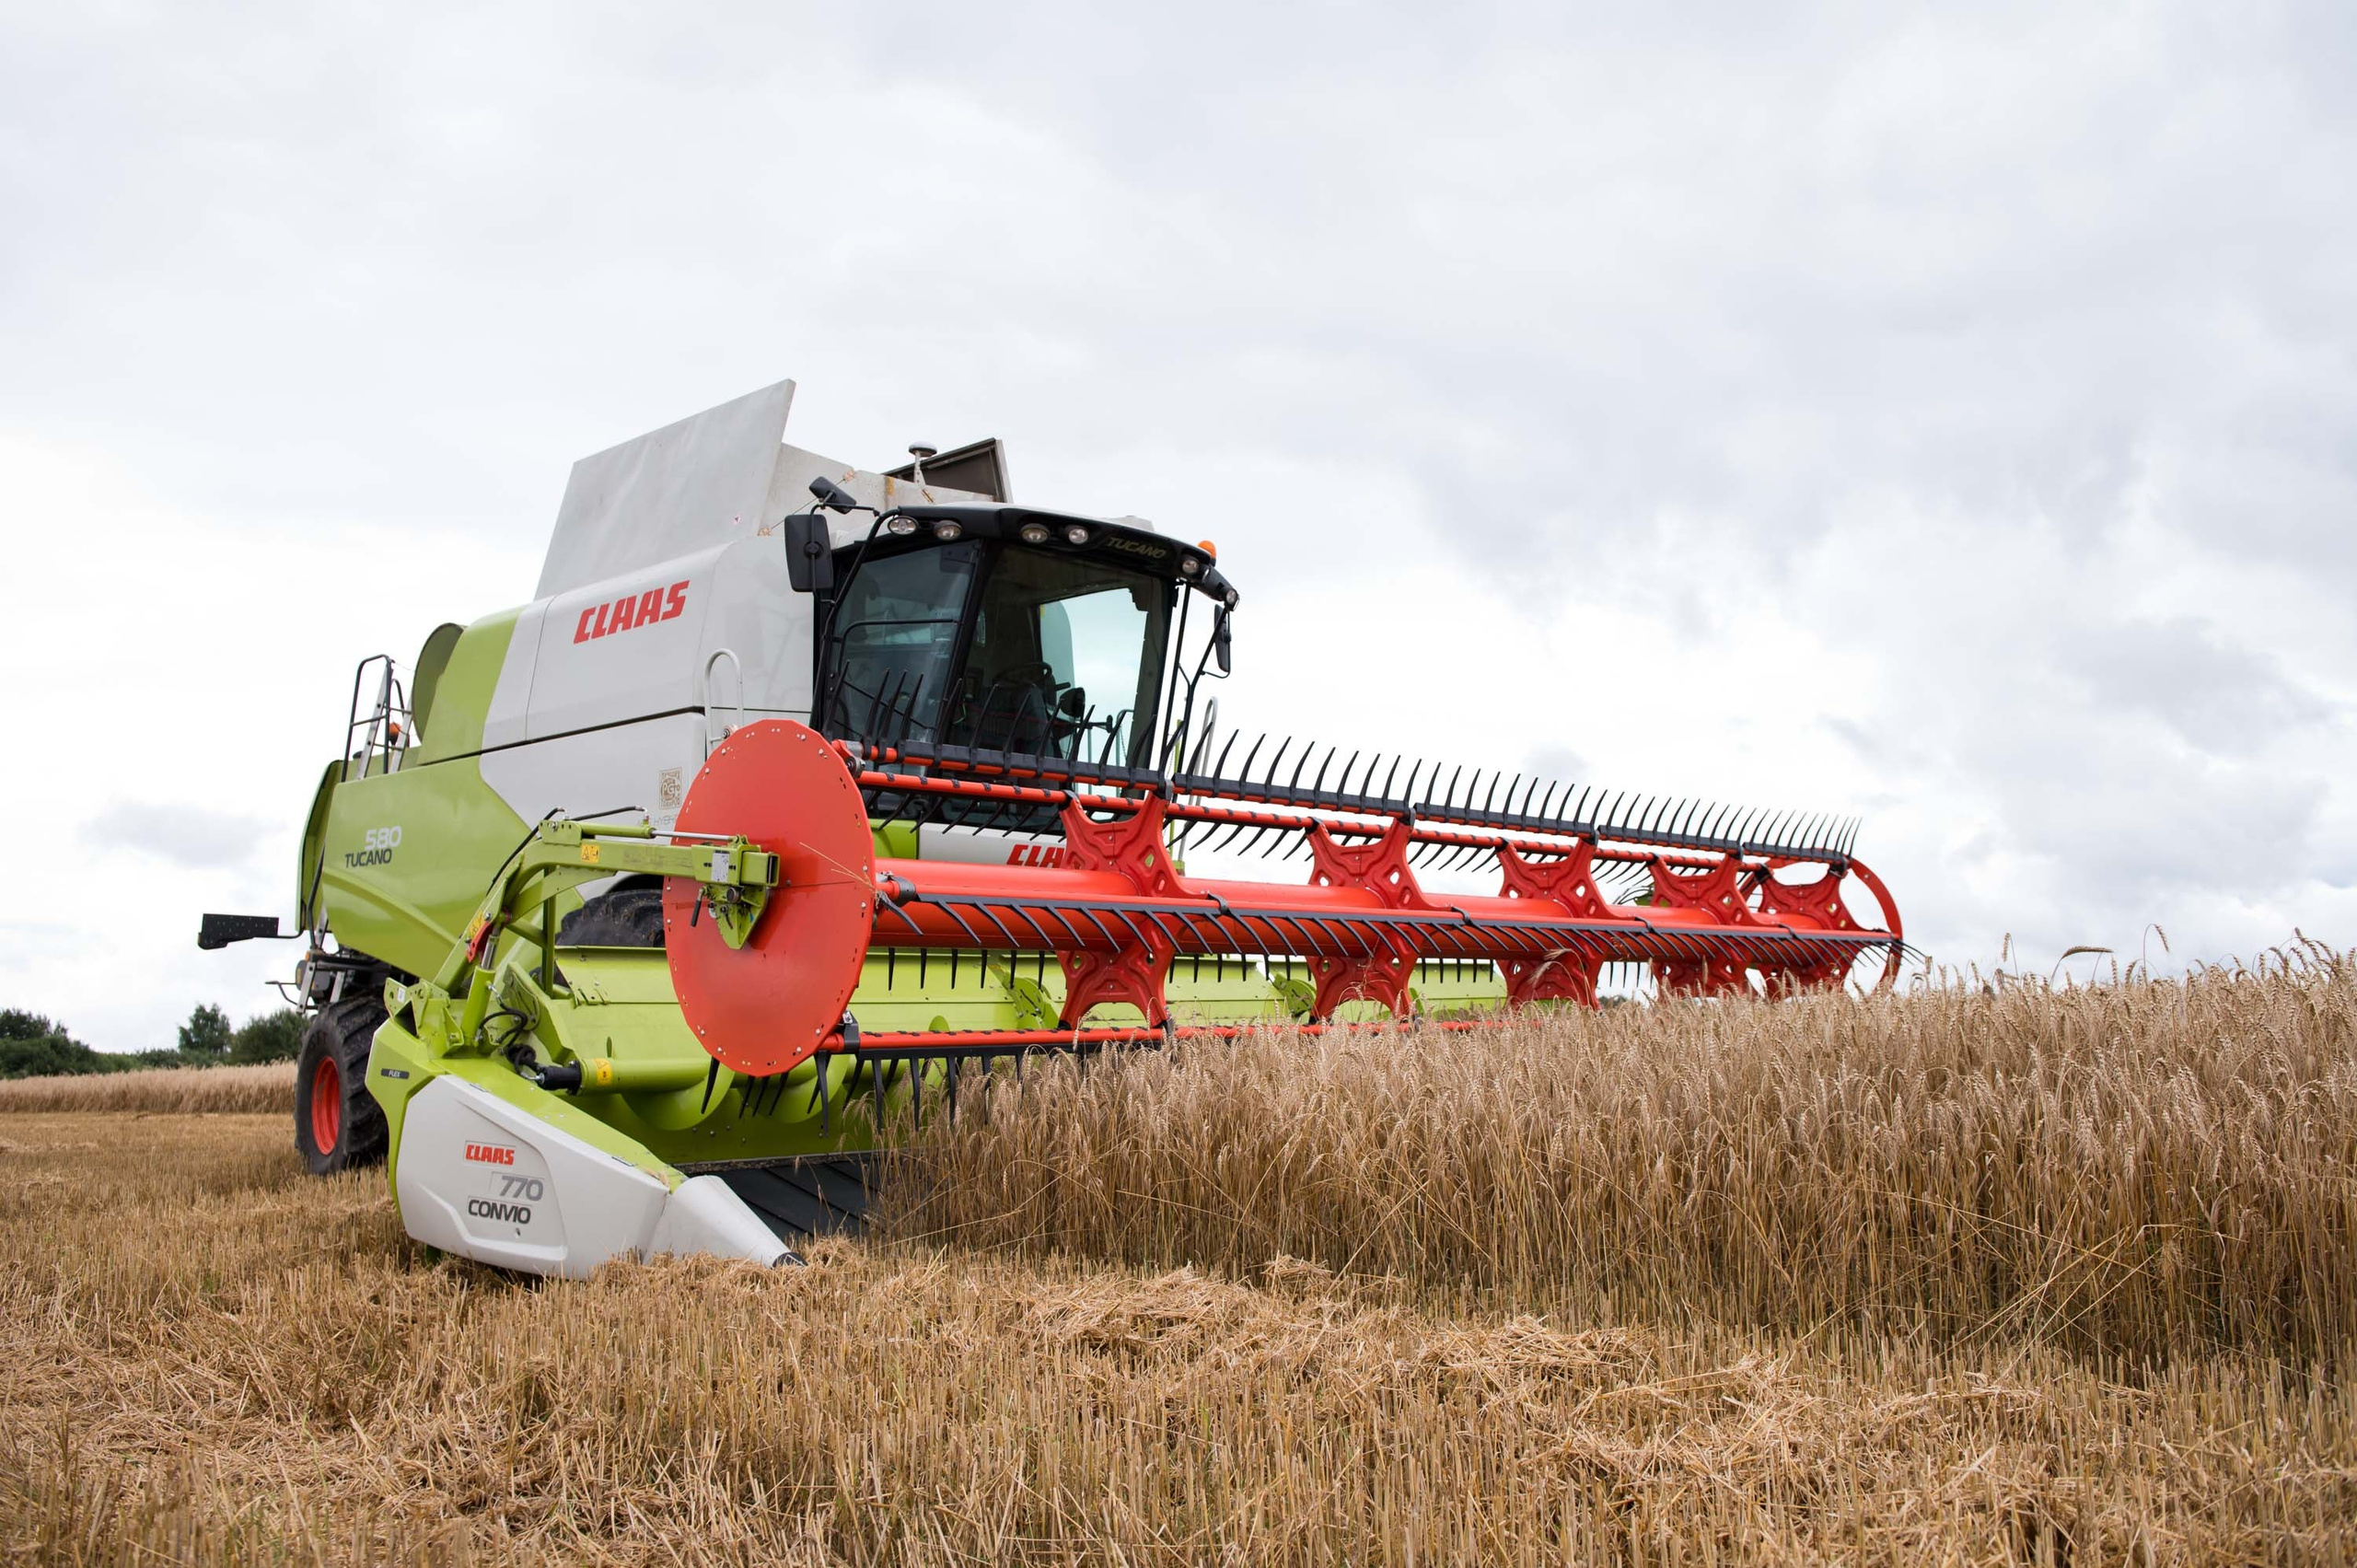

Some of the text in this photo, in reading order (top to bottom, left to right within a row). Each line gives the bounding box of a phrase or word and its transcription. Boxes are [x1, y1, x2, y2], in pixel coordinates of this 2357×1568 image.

[1107, 537, 1167, 559] TUCANO
[574, 580, 690, 645] CLAAS
[365, 825, 402, 851] 580
[345, 848, 392, 868] TUCANO
[1006, 843, 1065, 868] CLA
[388, 1070, 401, 1078] FLEX
[465, 1144, 516, 1166] CLAAS
[499, 1175, 543, 1202] 770
[468, 1199, 531, 1225] CONVIO
